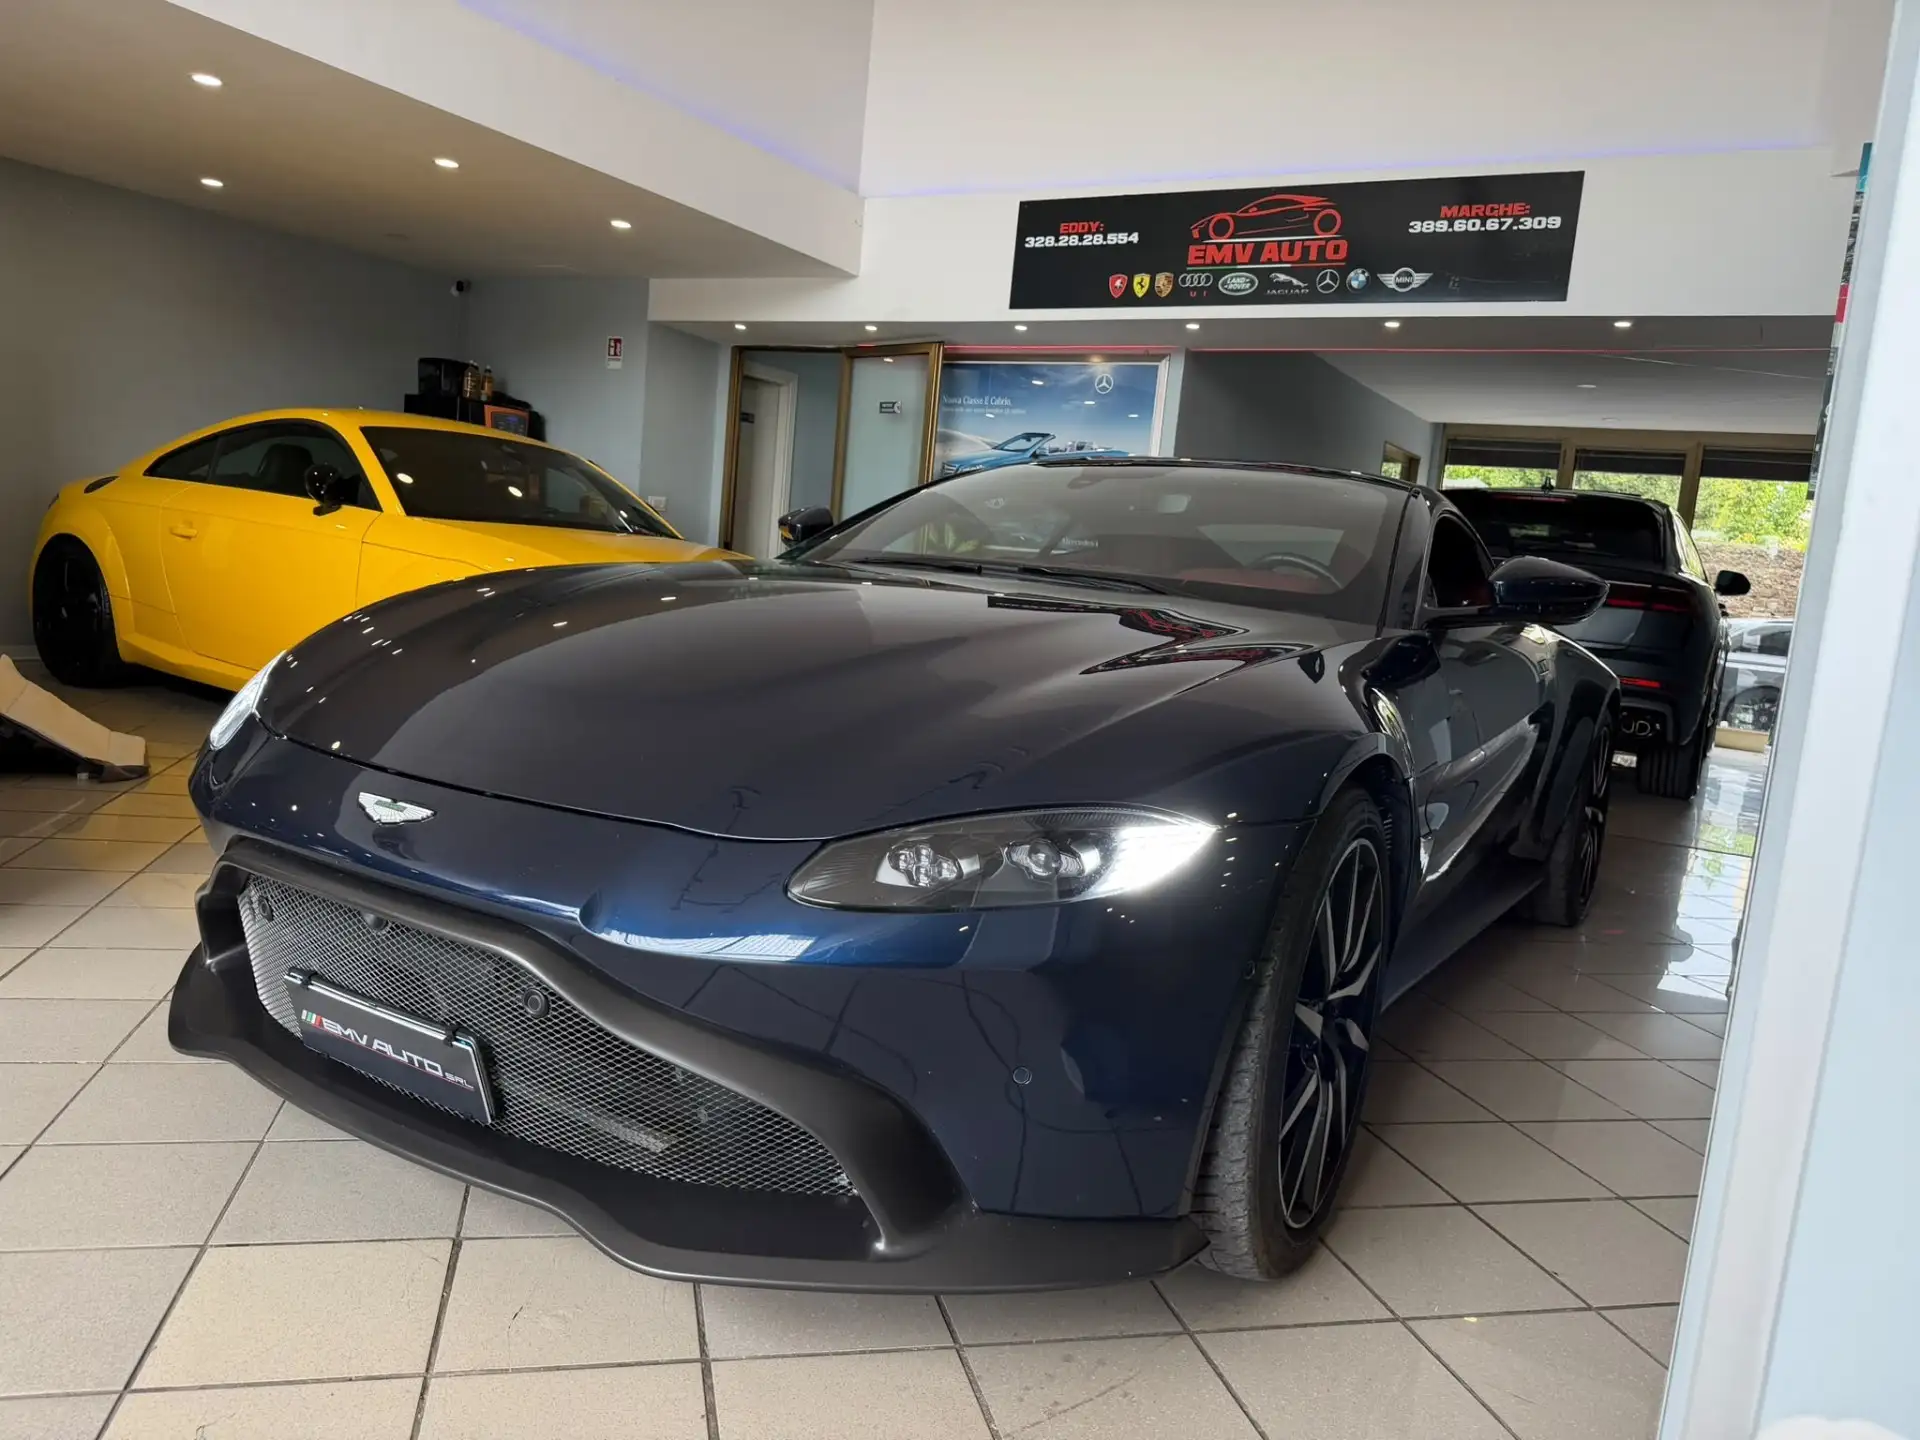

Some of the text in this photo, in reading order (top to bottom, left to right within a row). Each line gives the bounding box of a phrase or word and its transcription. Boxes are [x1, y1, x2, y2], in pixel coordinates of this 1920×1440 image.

[1440, 203, 1530, 218] MARCHE:
[1060, 221, 1105, 234] EDDY:
[1408, 216, 1562, 233] 389.60.67.309
[1024, 232, 1139, 248] 328.28.28.554
[1187, 239, 1348, 265] EMV AUTO
[1395, 276, 1413, 284] MINI
[1264, 288, 1310, 296] JAGUAR
[321, 1017, 475, 1090] EMV AUTO SRL
